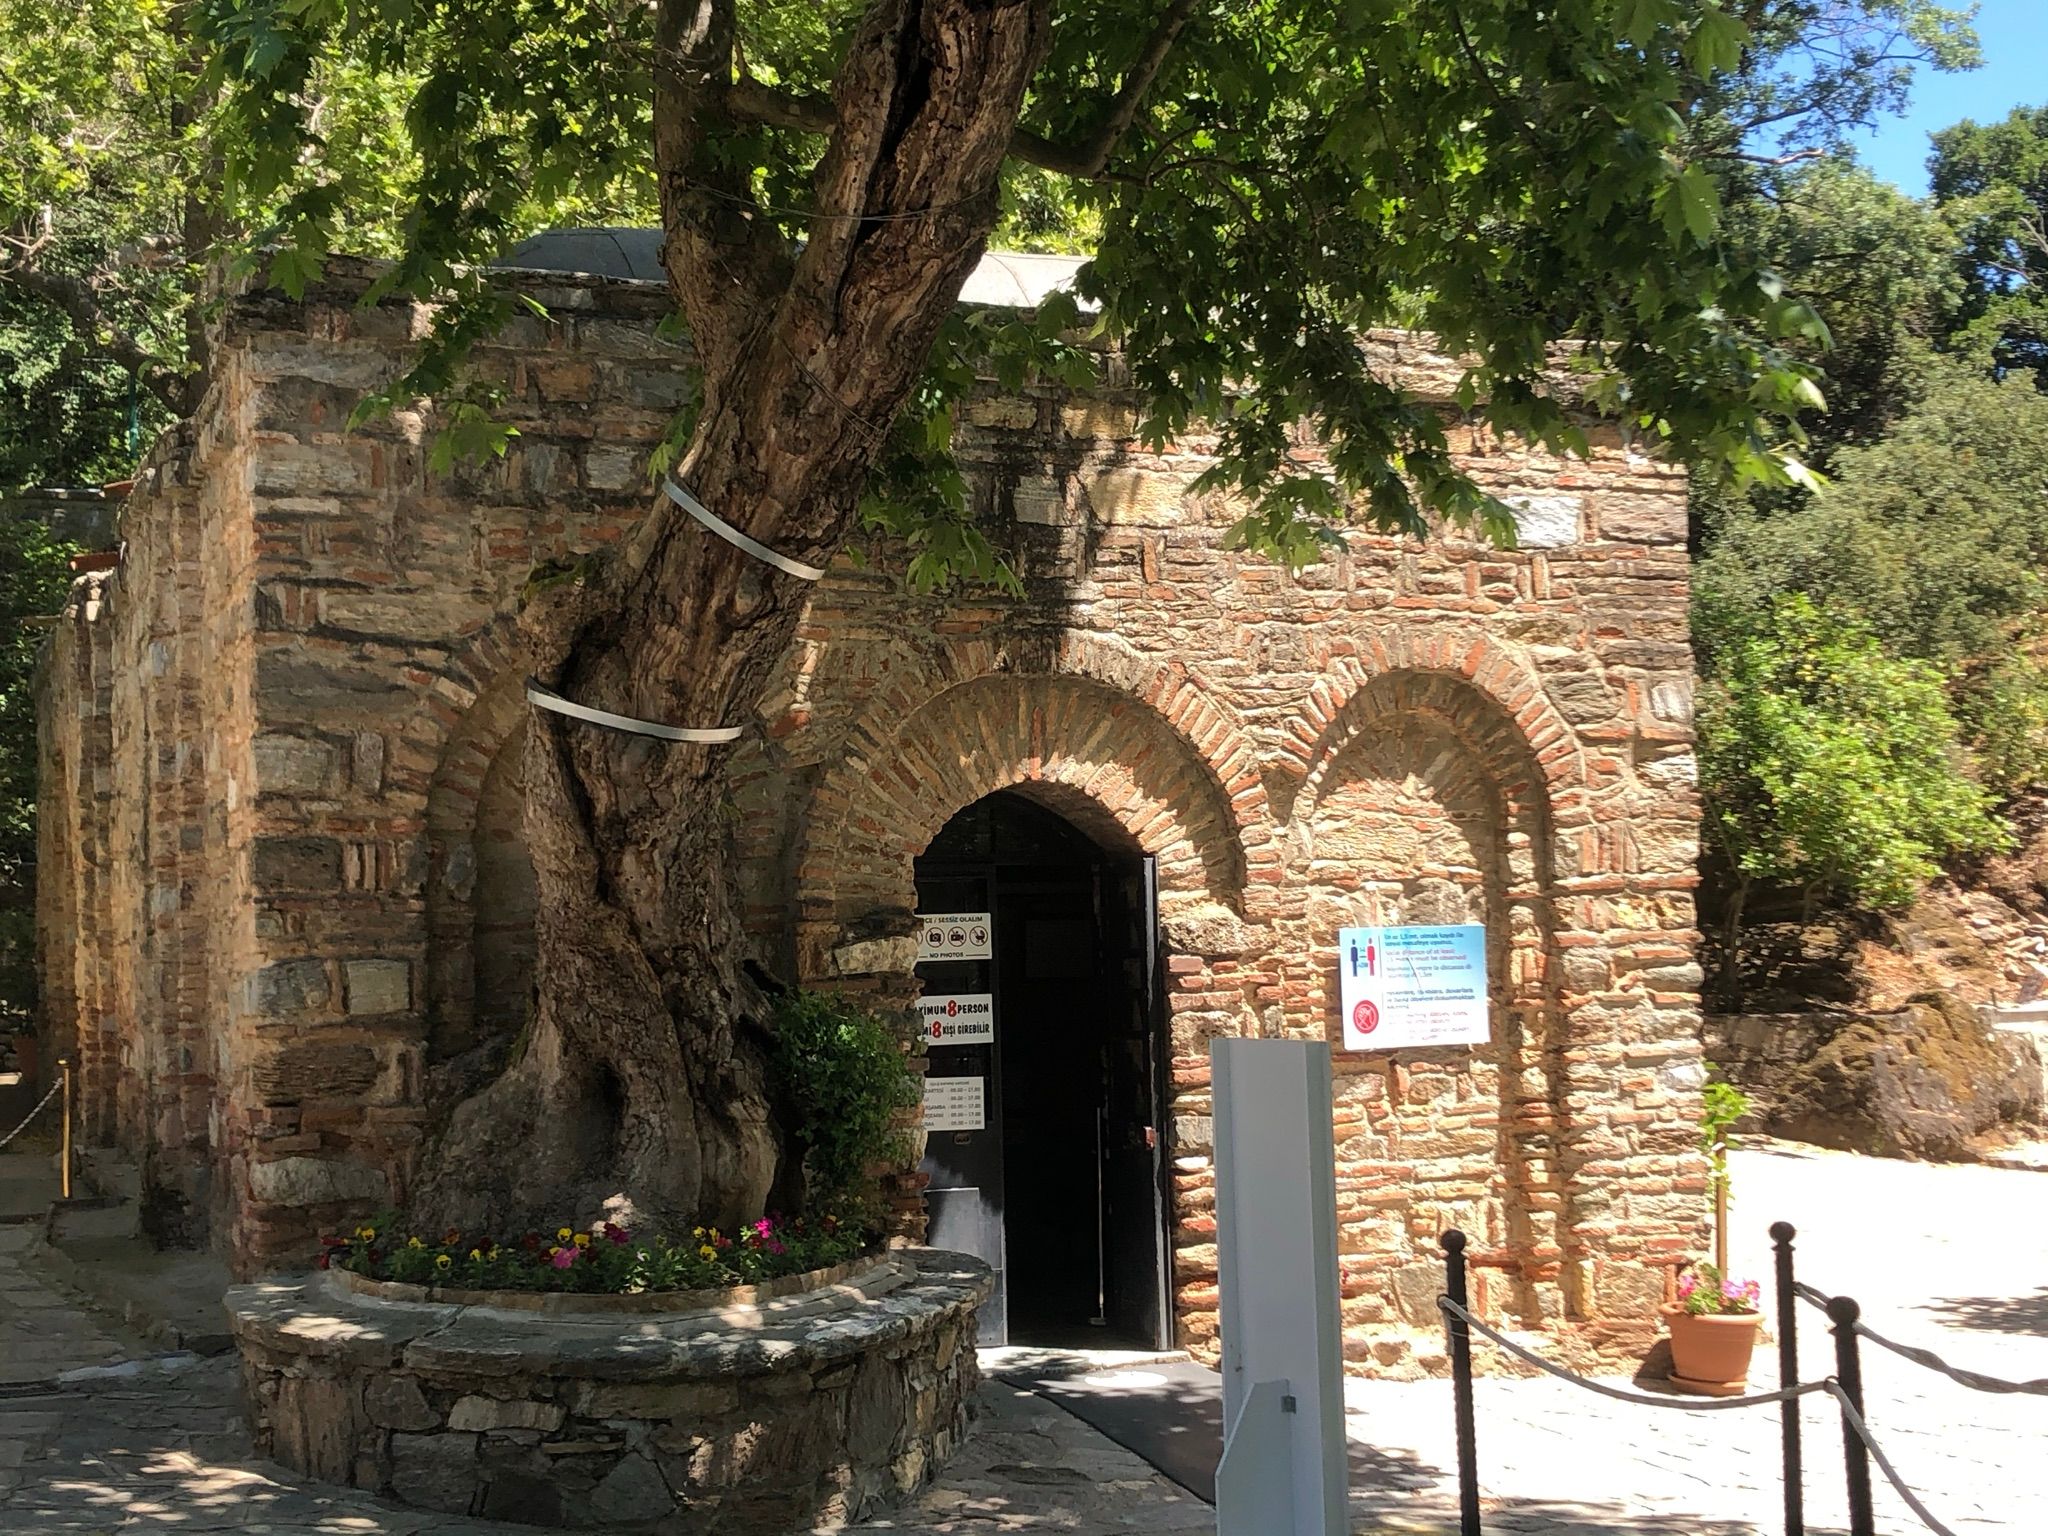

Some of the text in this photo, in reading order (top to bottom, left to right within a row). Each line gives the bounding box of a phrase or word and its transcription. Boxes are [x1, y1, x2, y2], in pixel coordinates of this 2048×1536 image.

[960, 915, 983, 923] OLALIM
[915, 1000, 989, 1017] XİMUM 8 PERSON
[932, 1021, 942, 1038] 8
[943, 1022, 955, 1037] KİŞİ
[957, 1021, 990, 1034] GİREBİLİR
